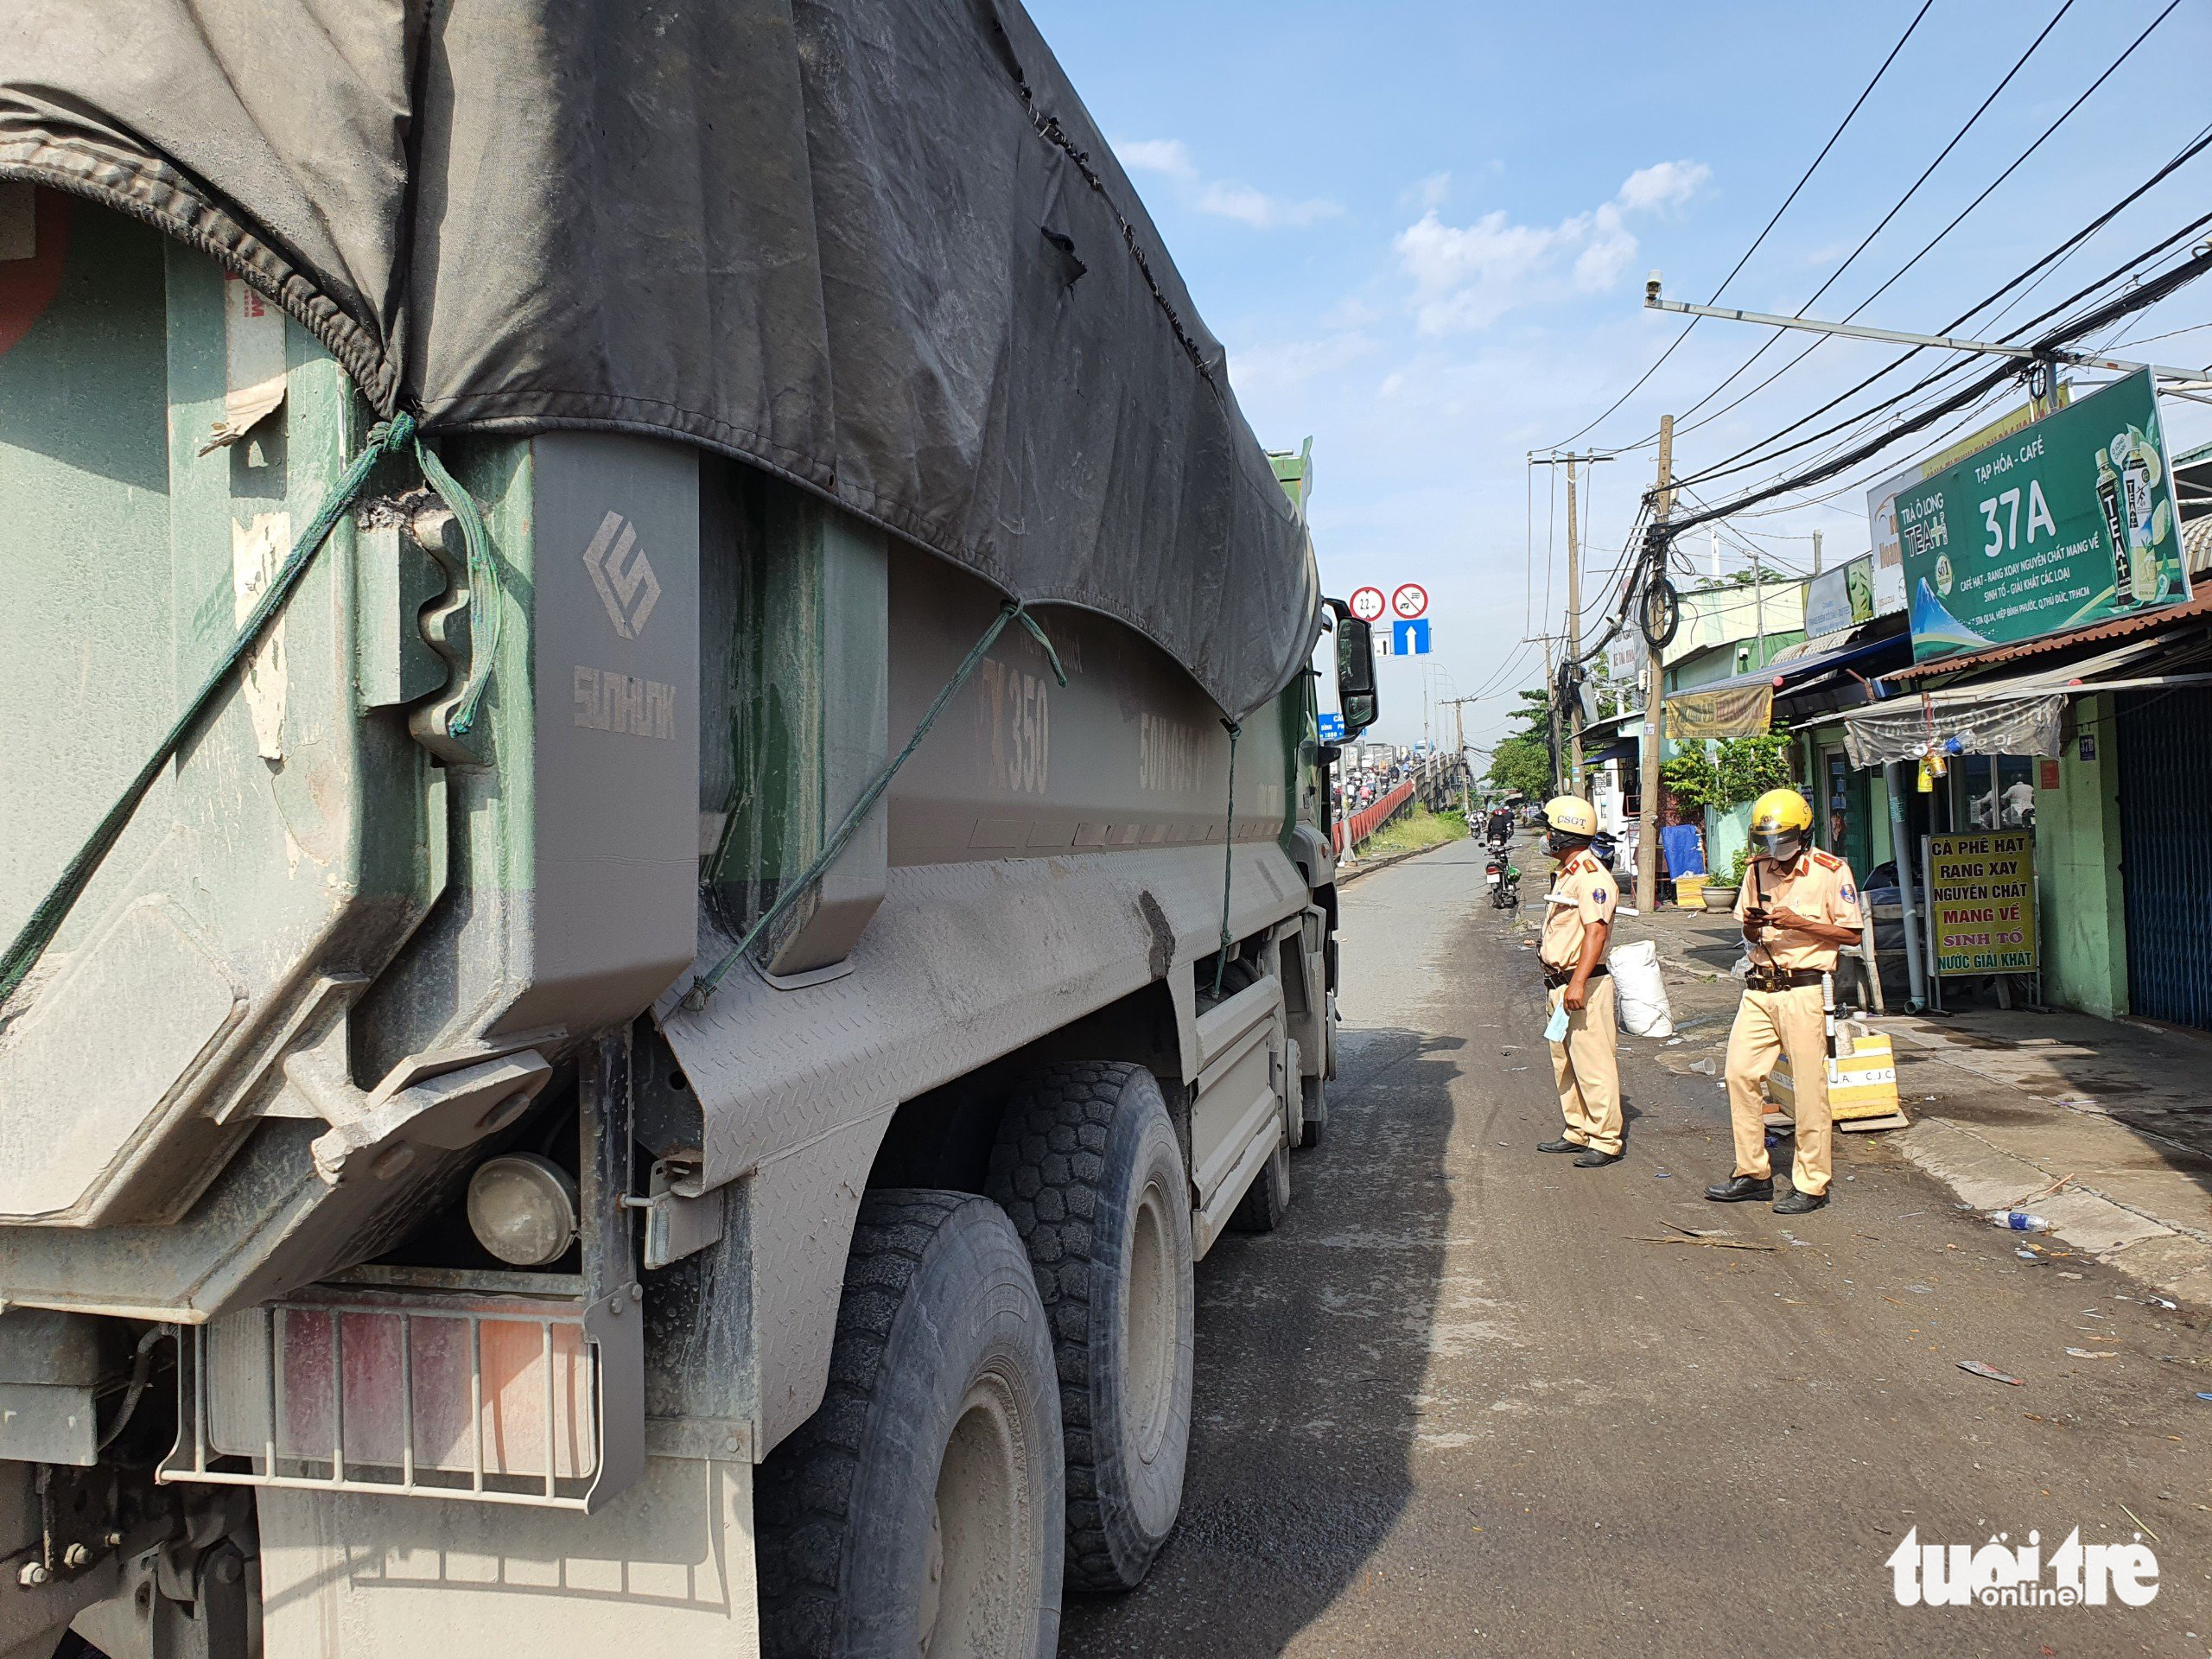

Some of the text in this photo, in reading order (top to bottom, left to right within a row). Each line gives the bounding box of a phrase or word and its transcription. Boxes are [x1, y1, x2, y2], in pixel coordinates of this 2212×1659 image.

[1975, 463, 1992, 485] TẠP
[1993, 453, 2013, 476] HÓA
[2020, 435, 2044, 463] CAFÉ
[1901, 502, 1916, 525] TRÀ
[1916, 498, 1923, 518] Ô
[1923, 492, 1944, 516] LONG
[1979, 480, 2056, 558] 37A
[1960, 575, 1973, 592] CAFÉ
[1973, 574, 1984, 590] HẠT
[1987, 568, 2004, 582] RANG
[2004, 563, 2020, 579] XOAY
[2020, 551, 2047, 572] NGUYÊN
[2047, 543, 2065, 563] CHẤT
[2066, 539, 2088, 558] MANG
[1984, 588, 1998, 603] SINH
[1998, 582, 2006, 599] TỐ
[2024, 572, 2040, 589] KHÁT
[2040, 568, 2054, 585] CÁC
[2055, 566, 2071, 582] LOẠI
[1995, 607, 2007, 621] HIỆP
[2006, 604, 2019, 617] BÌNH
[1557, 815, 1586, 827] CSGT
[1932, 837, 2025, 856] CÀ PHÊ HẠT
[1940, 861, 2018, 879] RANG XAY
[1934, 879, 2027, 902] NGUYÊN CHẤT
[1943, 908, 1994, 925] MANG
[1943, 926, 2024, 948] SINH TỐ
[1937, 949, 2031, 969] NƯỚC GIẢI KHÁT
